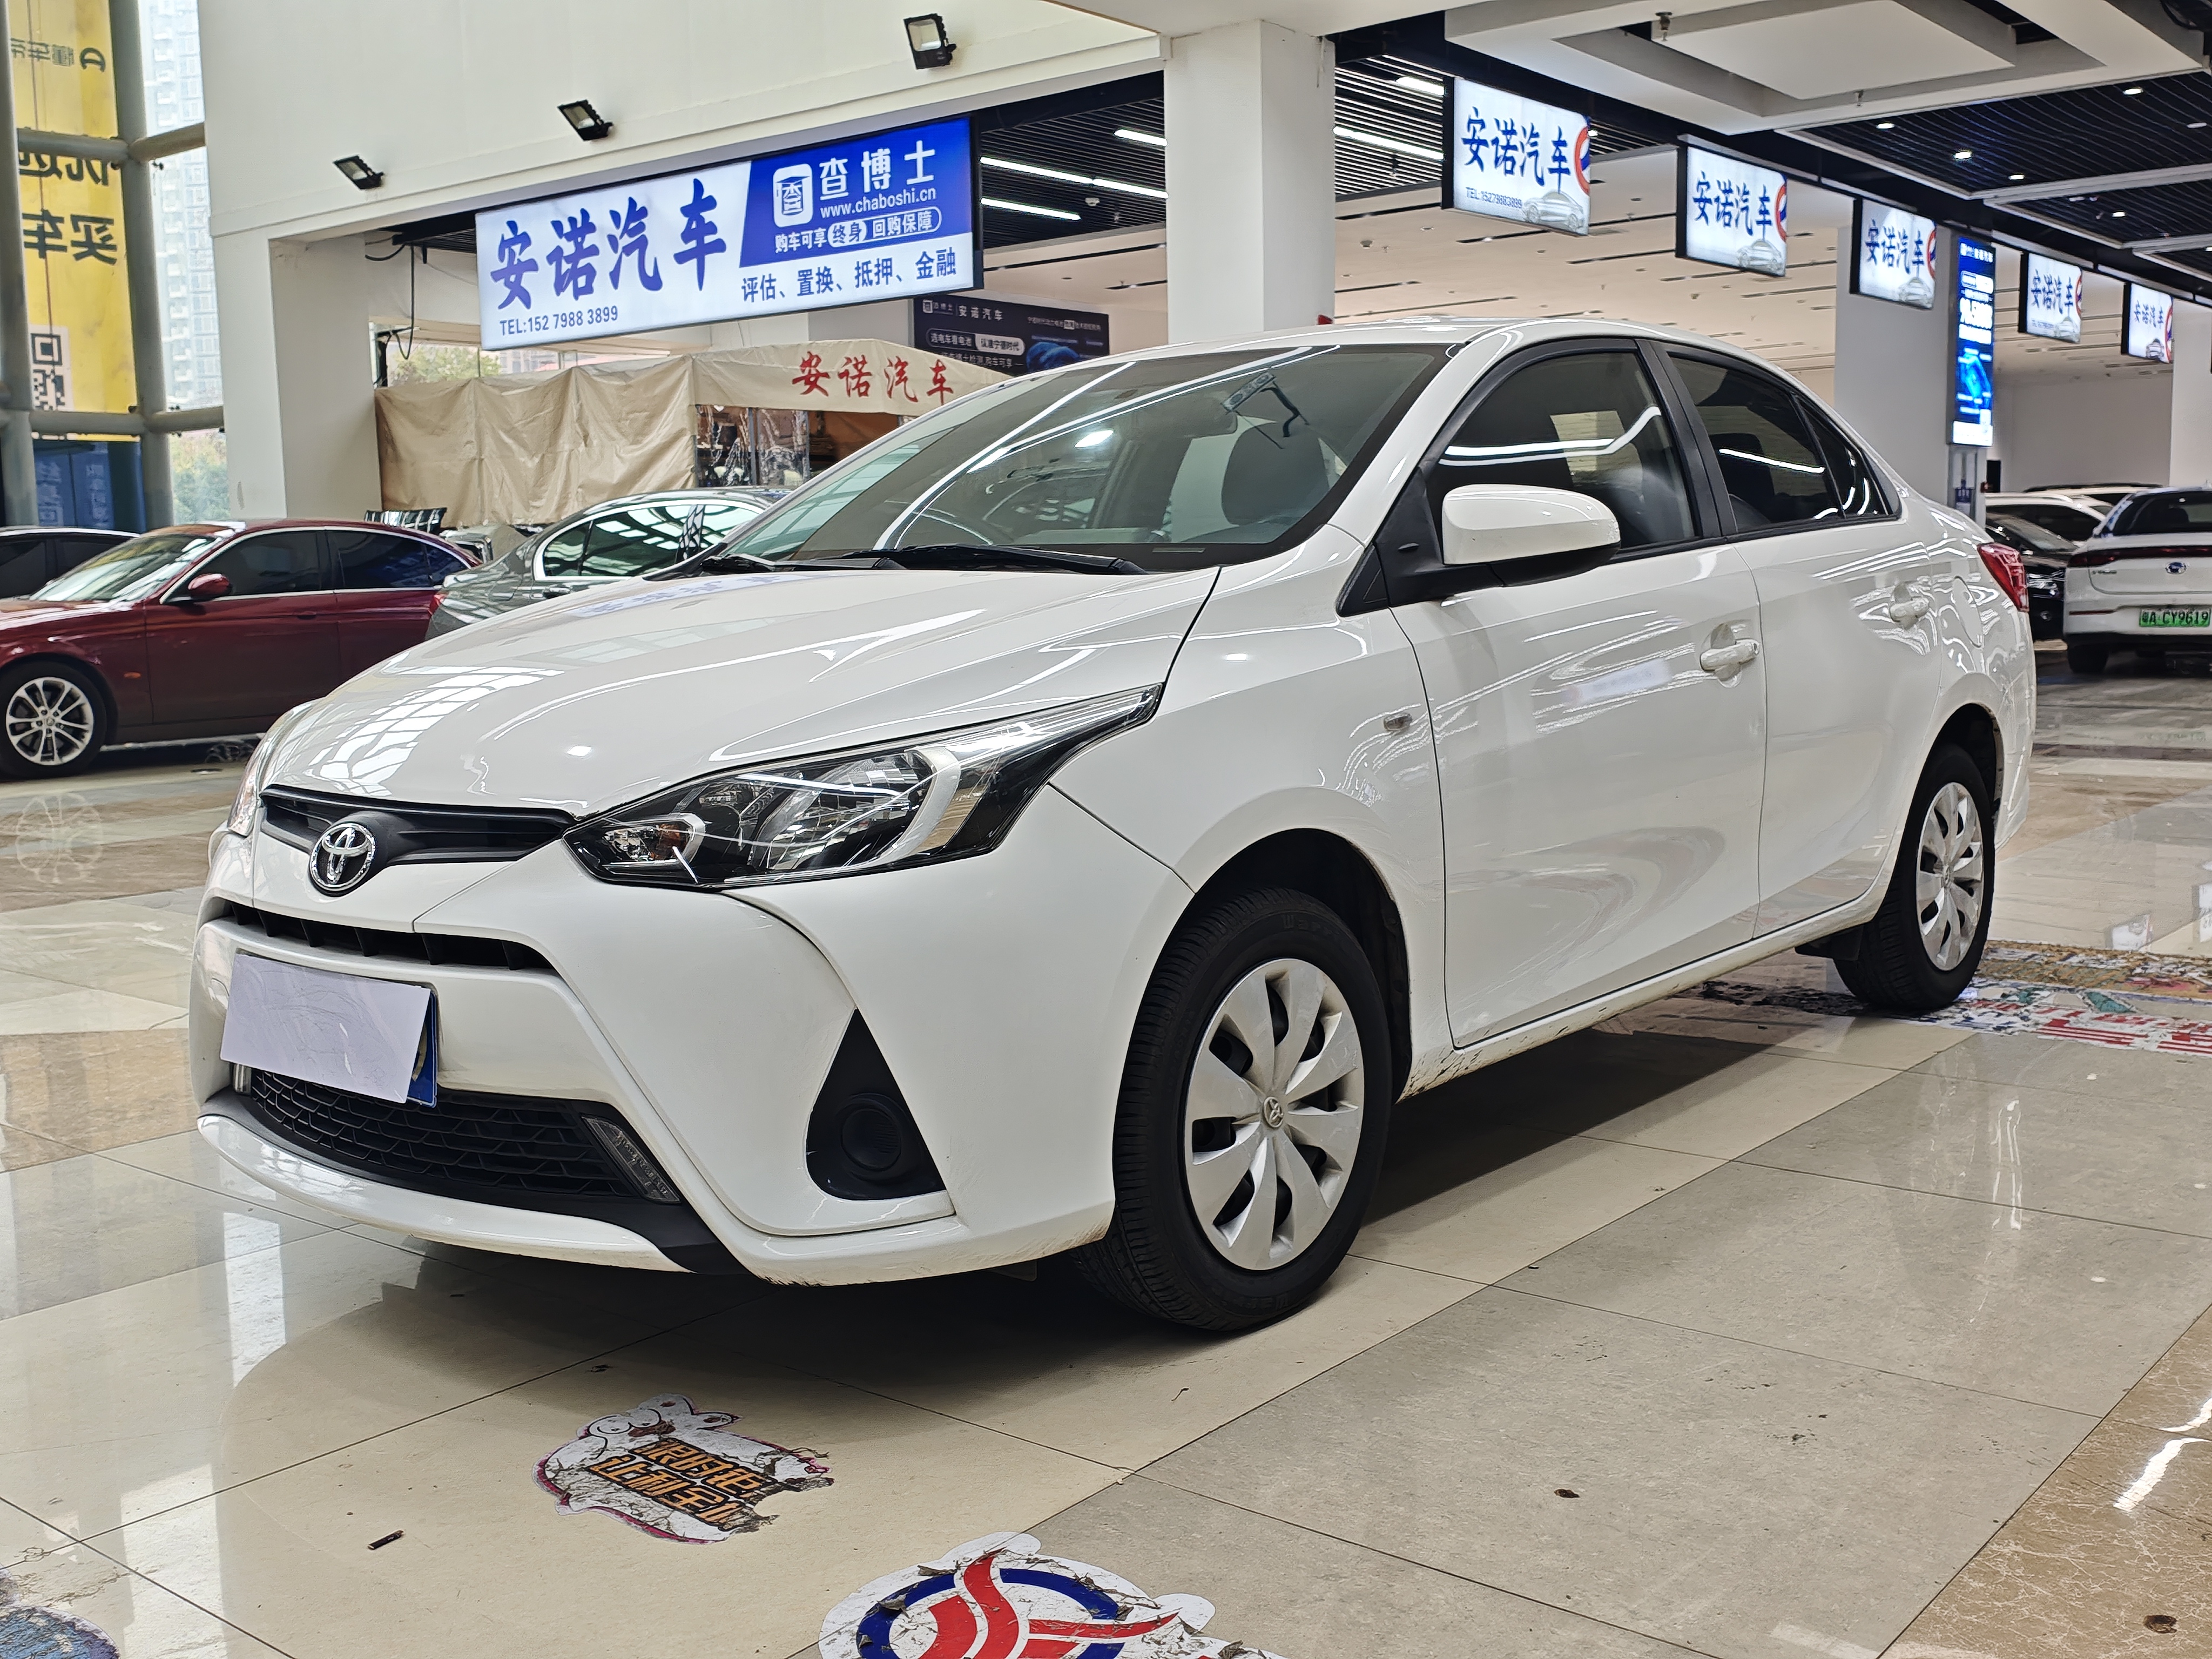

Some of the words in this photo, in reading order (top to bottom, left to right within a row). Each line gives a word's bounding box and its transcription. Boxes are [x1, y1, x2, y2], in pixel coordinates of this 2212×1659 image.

[1461, 106, 1571, 193] 安诺汽车
[820, 187, 936, 218] www.chaboshi.cn
[1692, 170, 1772, 241] 安诺汽车
[490, 178, 726, 310] 安诺汽车
[552, 310, 584, 329] 7988
[587, 305, 619, 325] 3899
[792, 351, 954, 405] 安诺汽车
